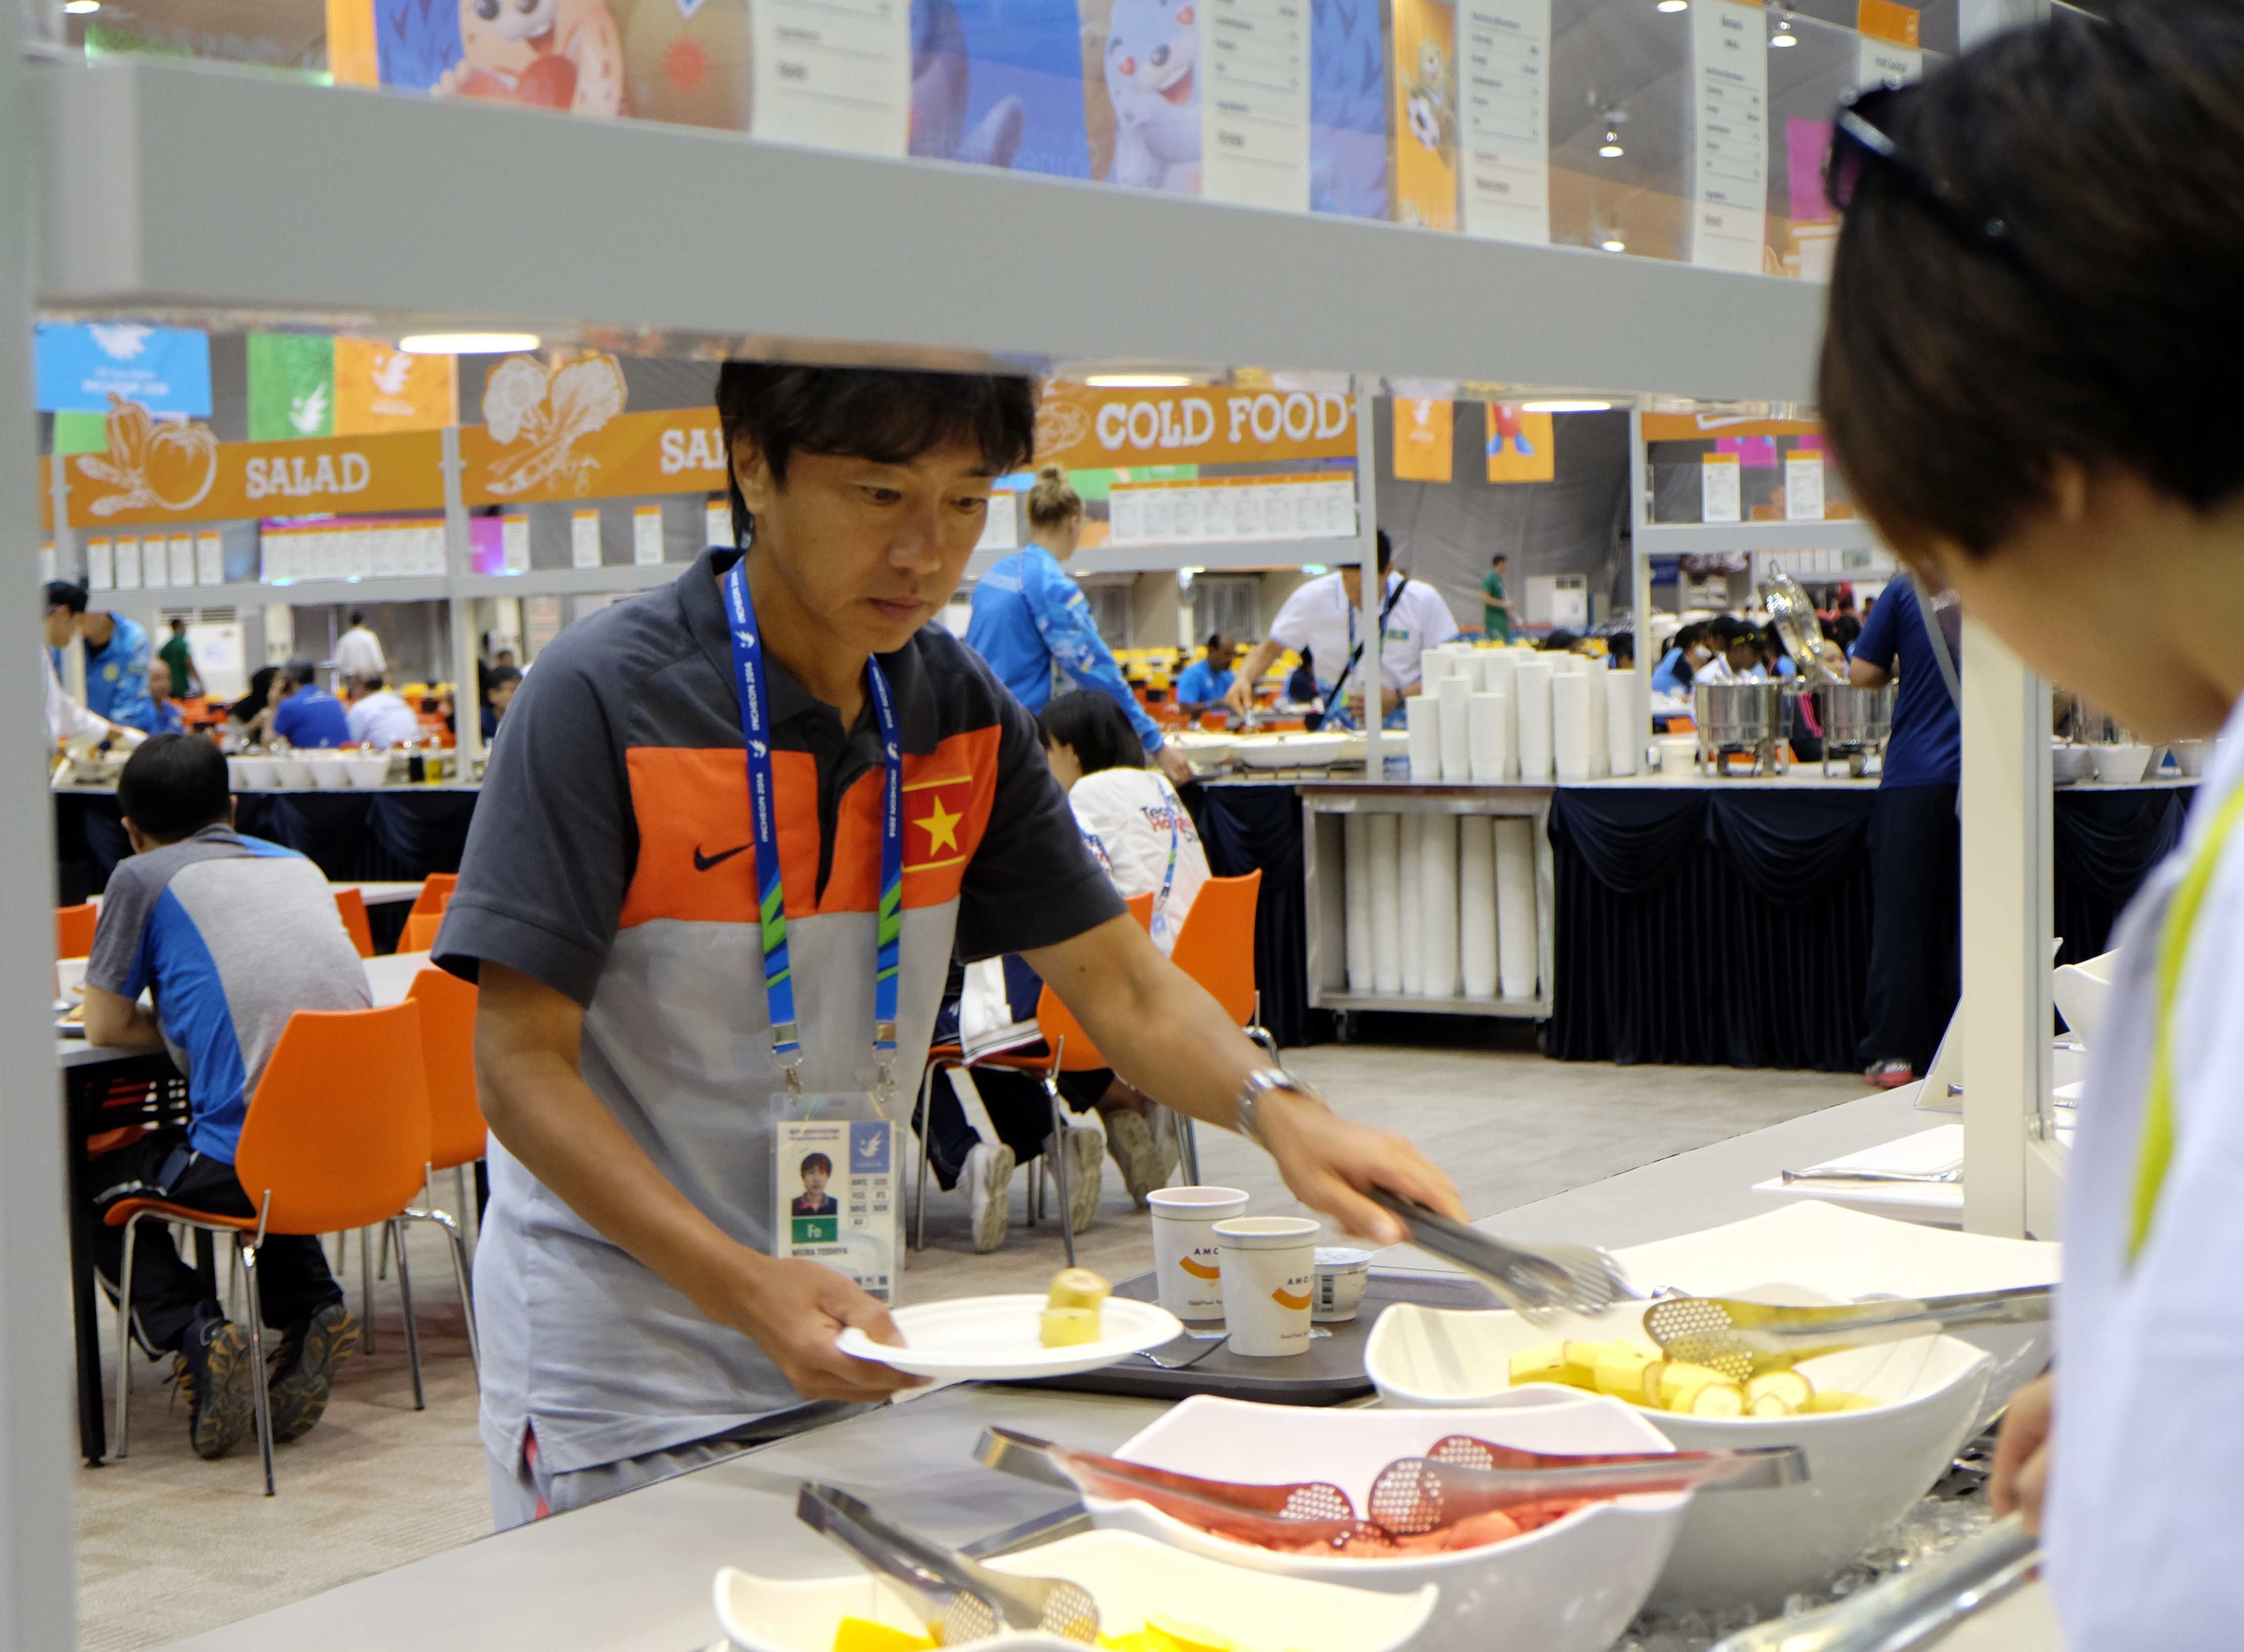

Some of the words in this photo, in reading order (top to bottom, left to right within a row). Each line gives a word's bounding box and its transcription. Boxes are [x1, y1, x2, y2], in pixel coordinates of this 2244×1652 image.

[1096, 397, 1215, 450] COLD
[1226, 392, 1349, 444] FOOD
[245, 451, 371, 500] SALAD
[660, 428, 728, 474] SAL
